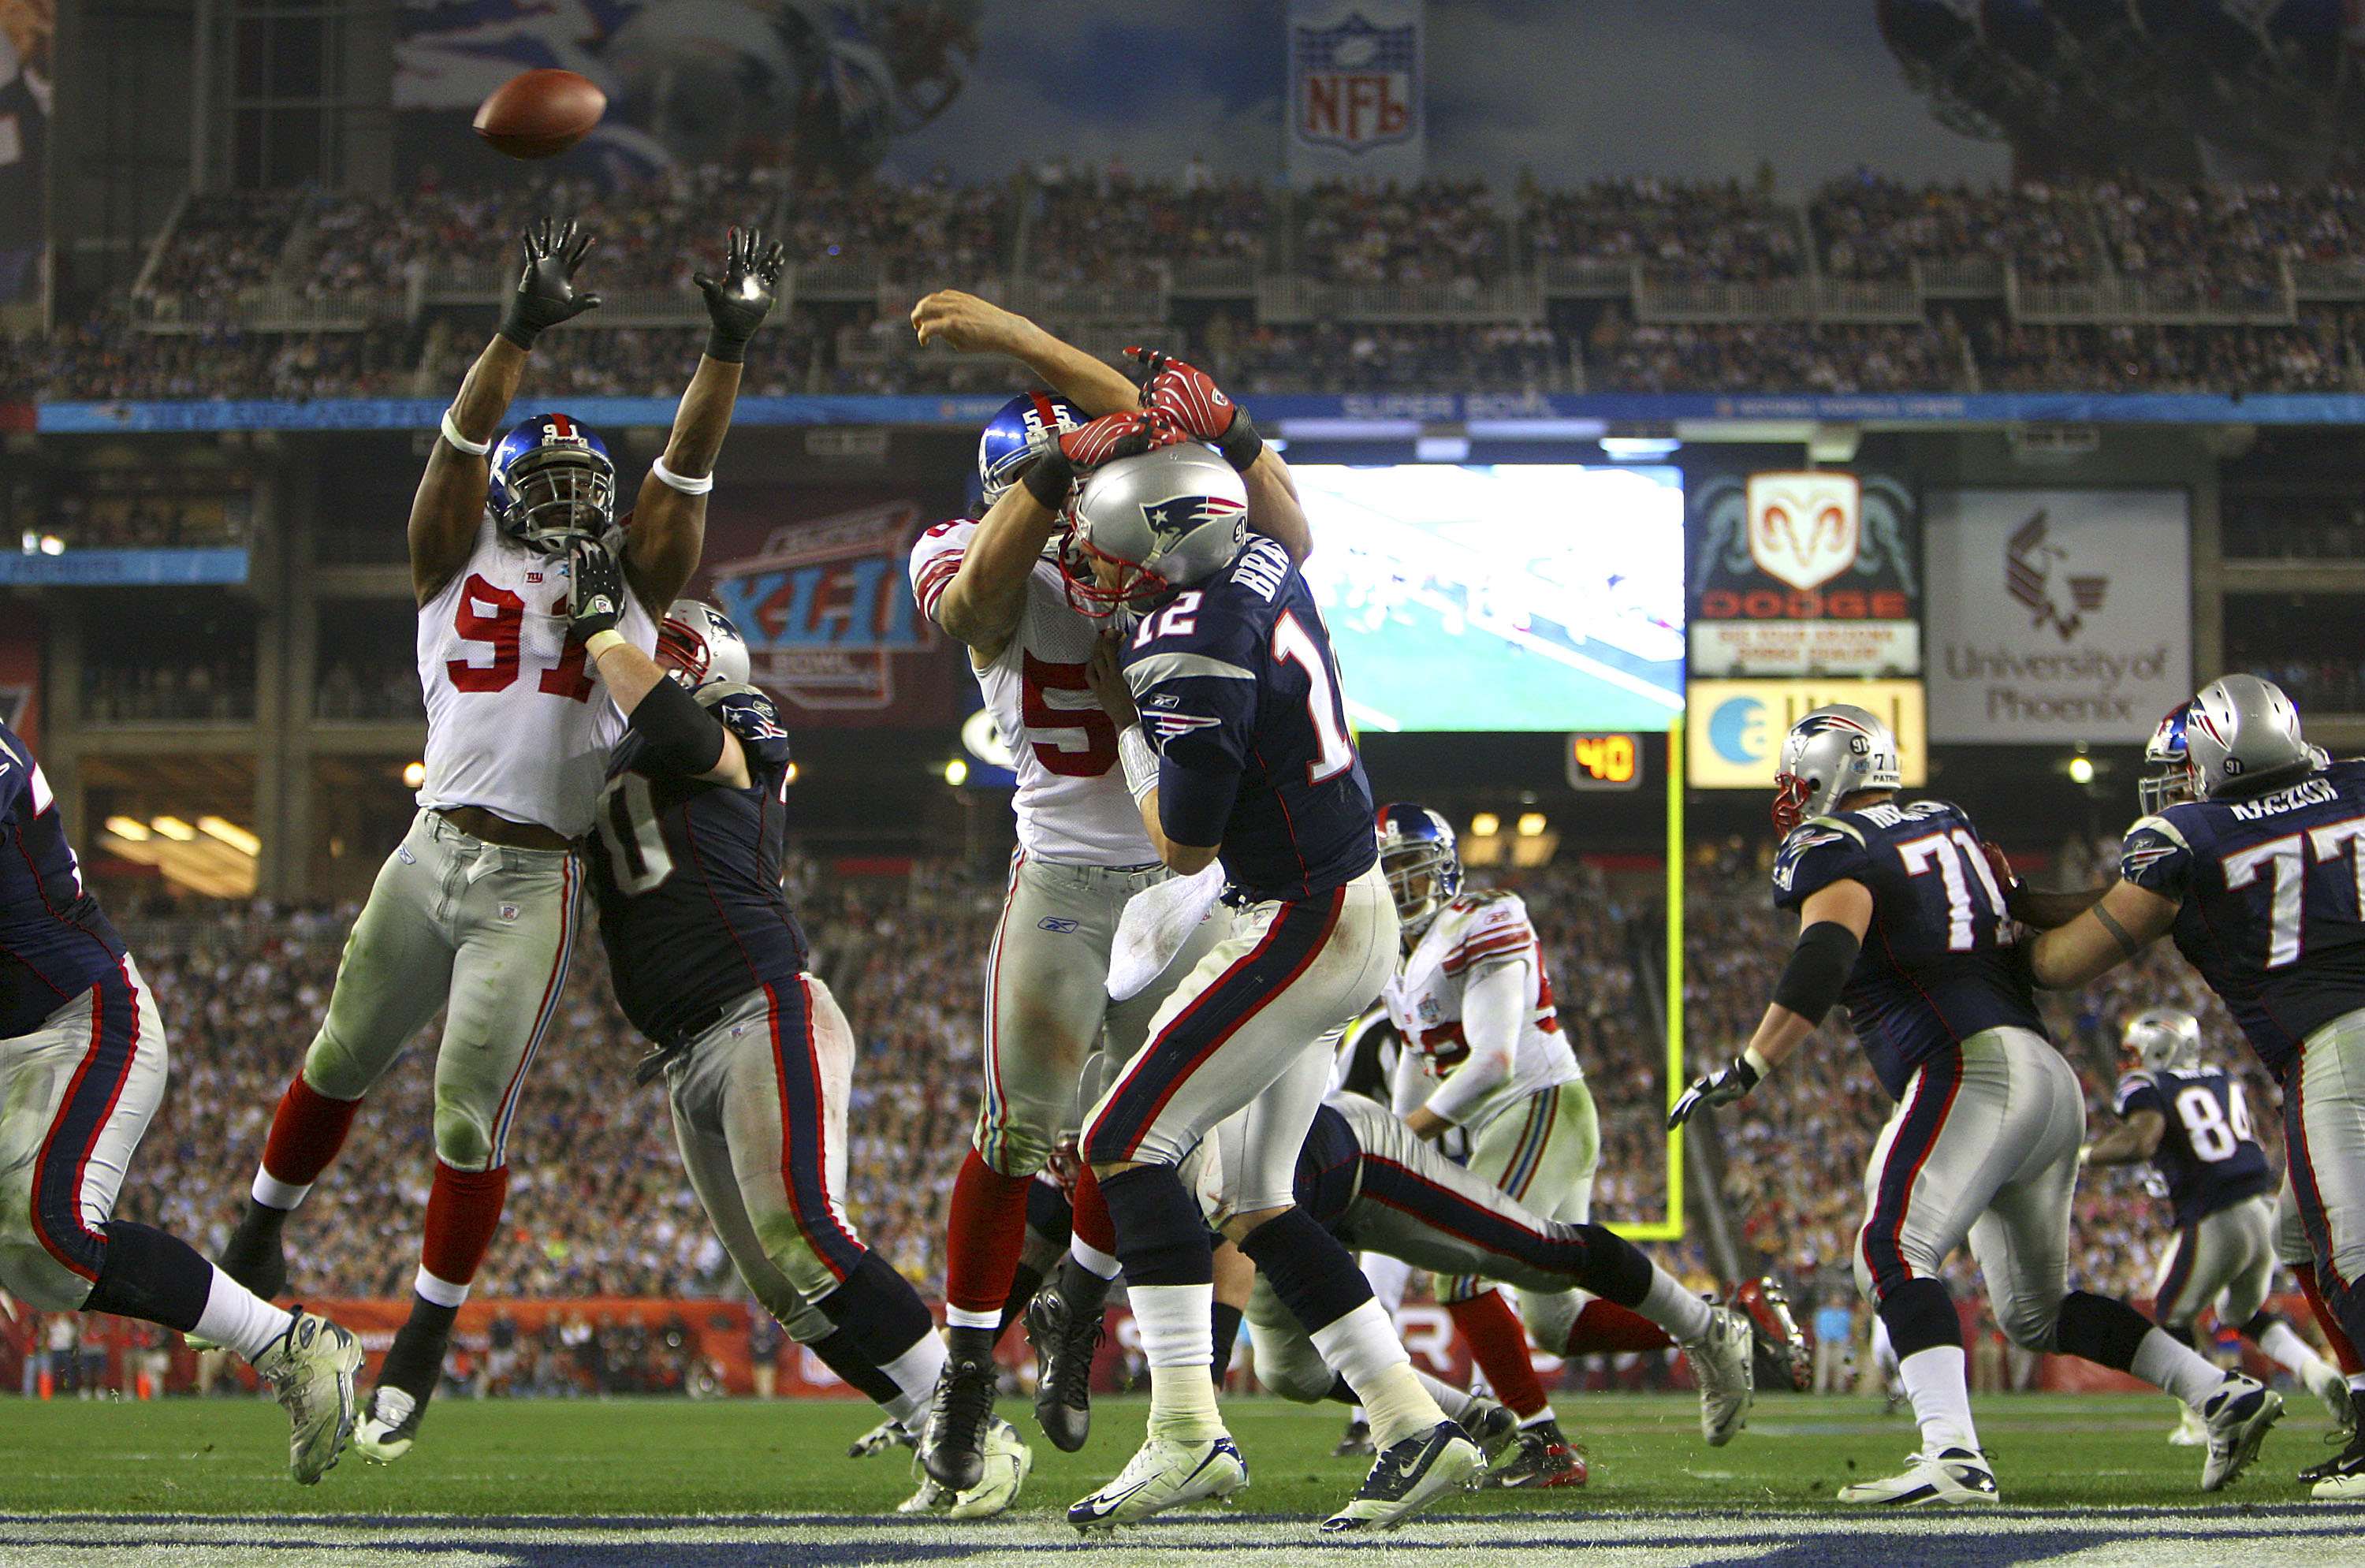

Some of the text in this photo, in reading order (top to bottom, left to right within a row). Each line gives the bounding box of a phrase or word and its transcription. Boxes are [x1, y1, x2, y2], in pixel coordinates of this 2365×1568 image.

[1309, 76, 1409, 141] NFL
[543, 423, 579, 440] 91
[1022, 404, 1071, 431] 55
[1231, 538, 1290, 603] BRA
[1131, 589, 1205, 650] 12
[1700, 590, 1909, 619] DODGE
[446, 573, 596, 704] 91
[1945, 643, 2168, 694] University of
[1986, 687, 2134, 723] Phoenix
[1574, 735, 1634, 781] 40
[2225, 760, 2241, 774] 91
[1895, 826, 2013, 952] 71
[2176, 1082, 2266, 1164] 84
